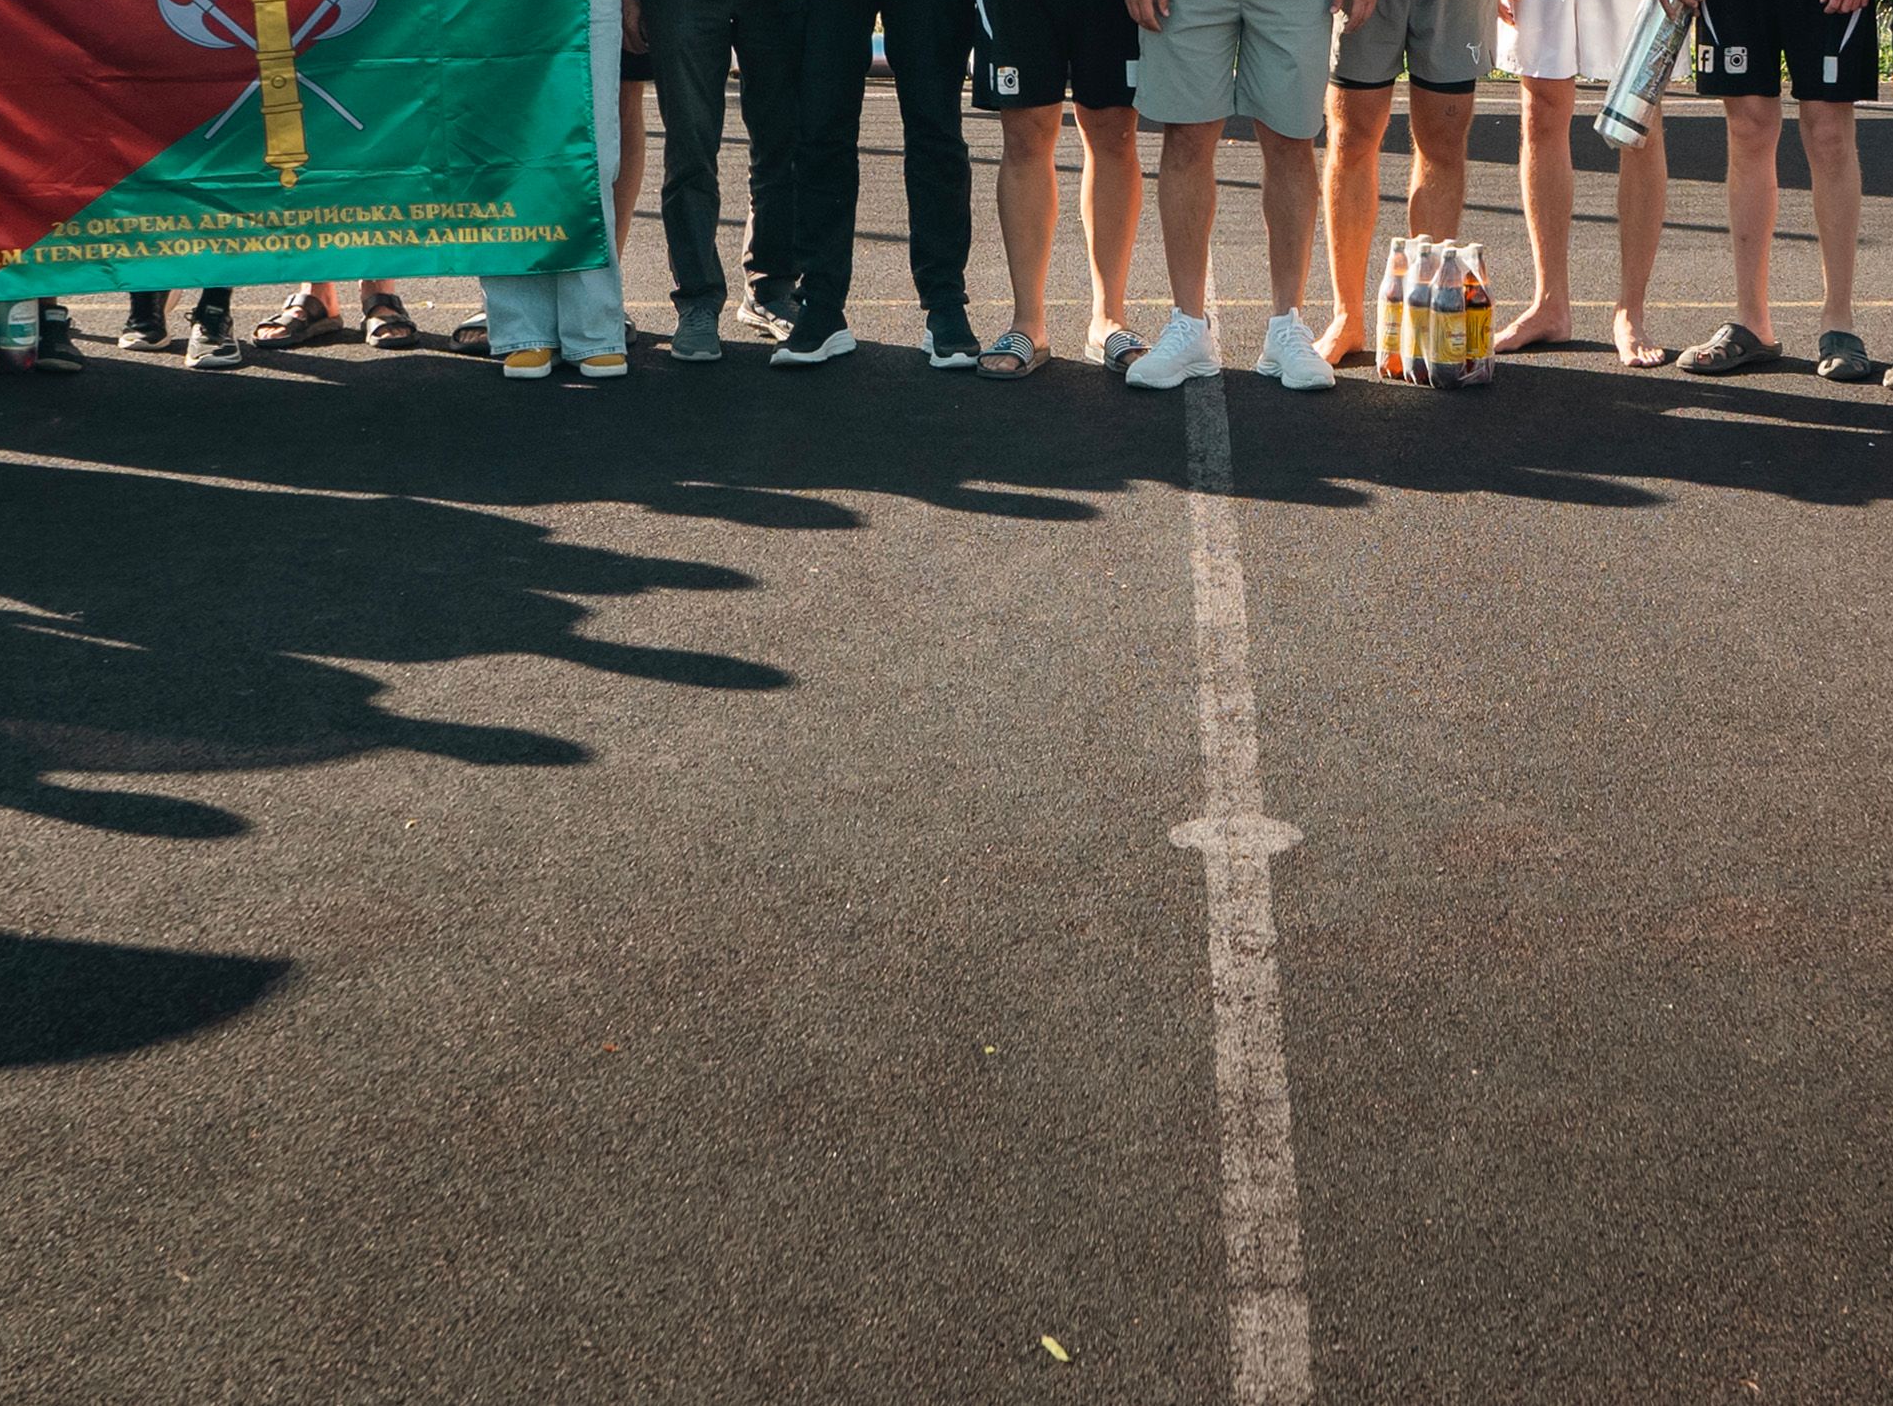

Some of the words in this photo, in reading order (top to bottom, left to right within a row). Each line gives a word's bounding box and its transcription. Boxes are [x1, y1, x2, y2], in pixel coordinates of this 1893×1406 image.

[51, 221, 81, 238] 26
[87, 214, 193, 236] ОКРЕМА
[198, 204, 405, 231] АРТИЛЕРІЙСЬКА
[409, 201, 517, 221] БРИГАДА
[423, 225, 570, 247] ДАШКЕВИЧА
